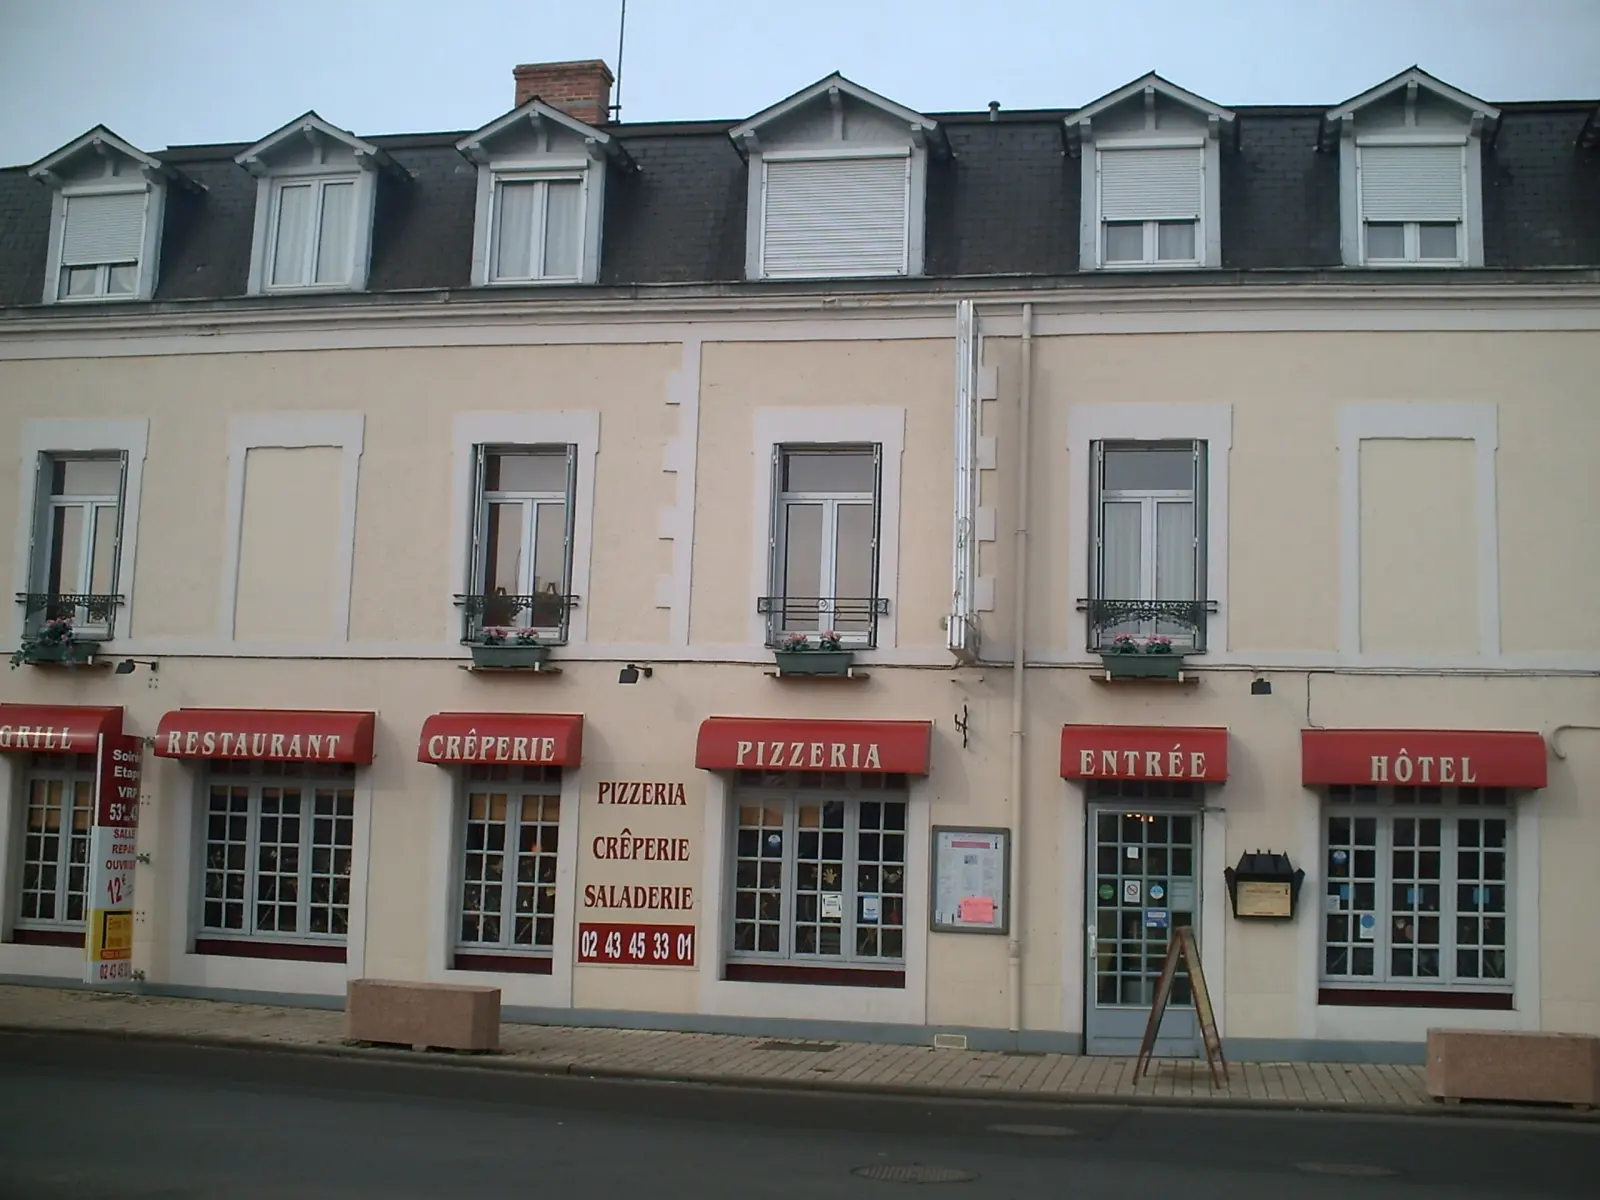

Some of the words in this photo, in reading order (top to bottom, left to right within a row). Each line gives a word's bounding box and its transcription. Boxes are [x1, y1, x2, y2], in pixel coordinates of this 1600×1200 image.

[0, 725, 72, 750] GRILL
[166, 731, 341, 759] RESTAURANT
[427, 728, 555, 762] CRÊPERIE
[735, 740, 882, 769] PIZZERIA
[1079, 743, 1207, 778] ENTRÉE
[1370, 747, 1478, 783] HÔTEL
[597, 781, 687, 806] PIZZERIA
[592, 827, 691, 862] CRÊPERIE
[583, 884, 693, 911] SALADERIE
[581, 930, 598, 958] 02
[604, 931, 622, 959] 43
[628, 932, 646, 959] 45
[653, 933, 670, 960] 33
[677, 933, 692, 961] 01
